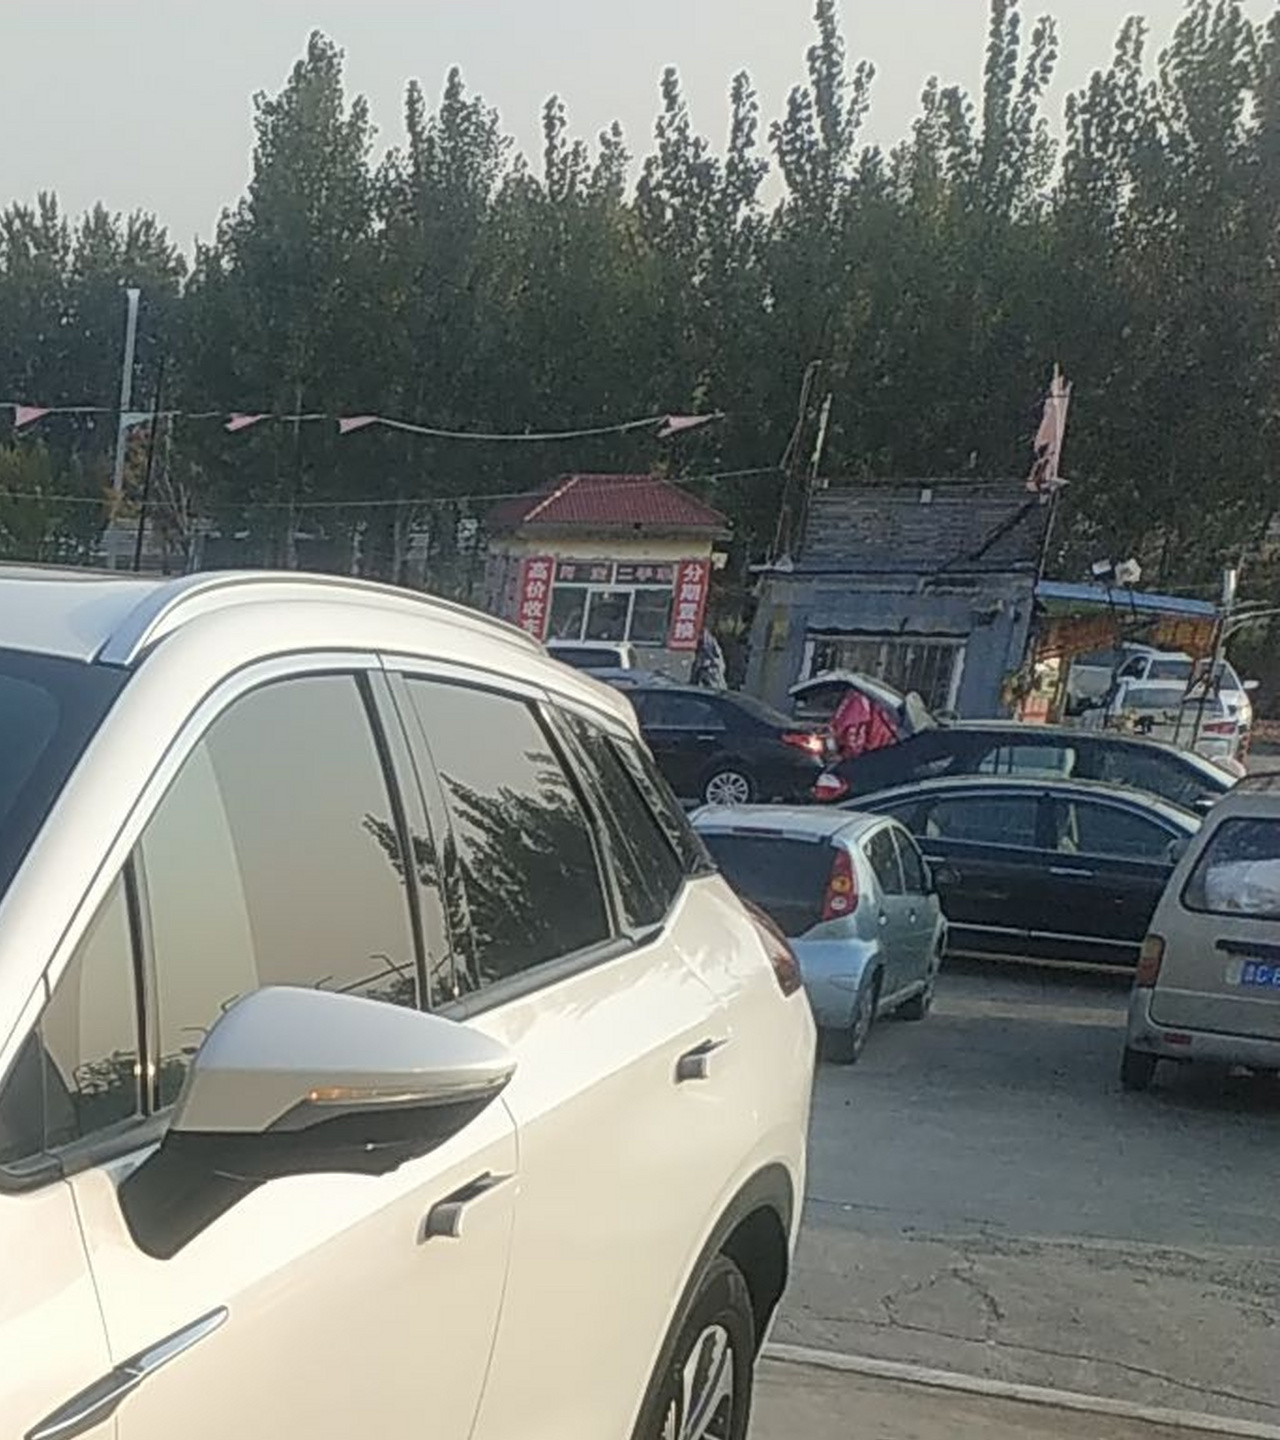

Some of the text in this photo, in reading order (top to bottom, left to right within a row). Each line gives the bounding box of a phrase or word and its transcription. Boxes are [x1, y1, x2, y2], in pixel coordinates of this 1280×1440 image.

[522, 561, 549, 635] 高价收车
[674, 562, 704, 640] 分期置换
